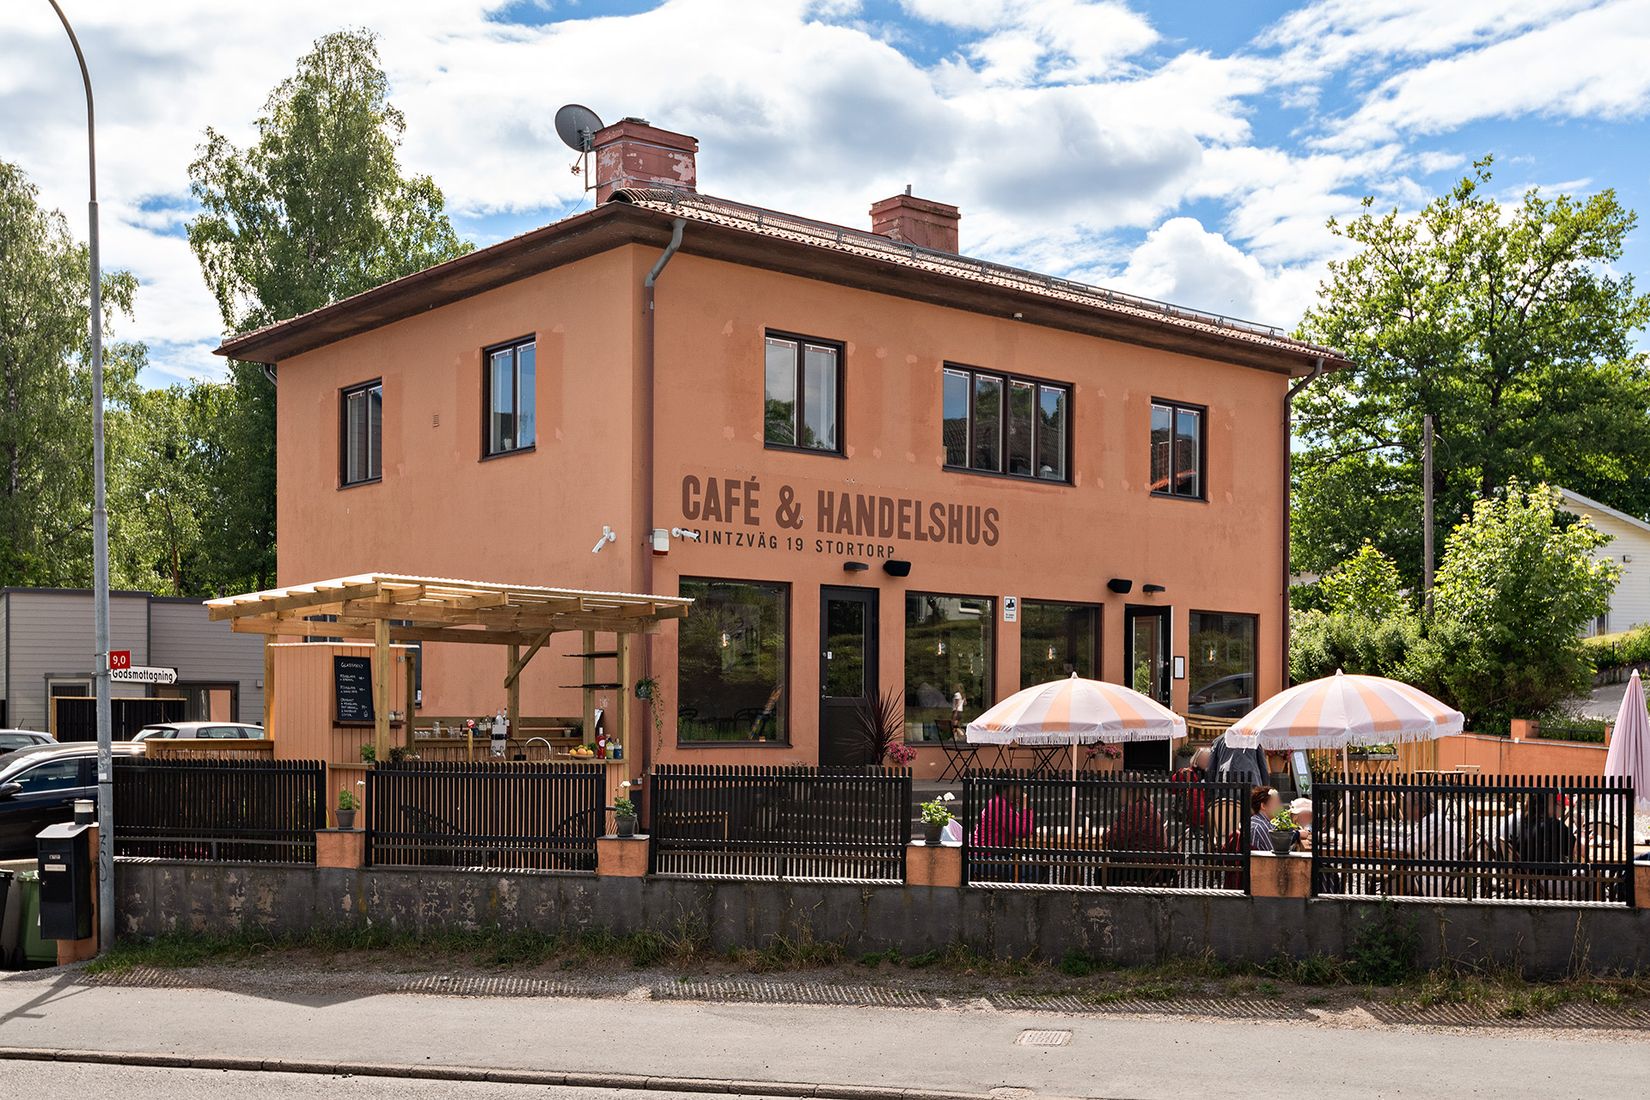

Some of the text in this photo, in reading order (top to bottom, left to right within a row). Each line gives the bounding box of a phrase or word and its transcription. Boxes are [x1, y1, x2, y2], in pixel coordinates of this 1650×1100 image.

[682, 475, 1000, 547] CAFÉ & HANDELSHUS
[787, 536, 804, 551] 19
[815, 540, 895, 559] STORTORP
[112, 655, 126, 667] 9,0
[112, 668, 173, 684] Godsmottagning
